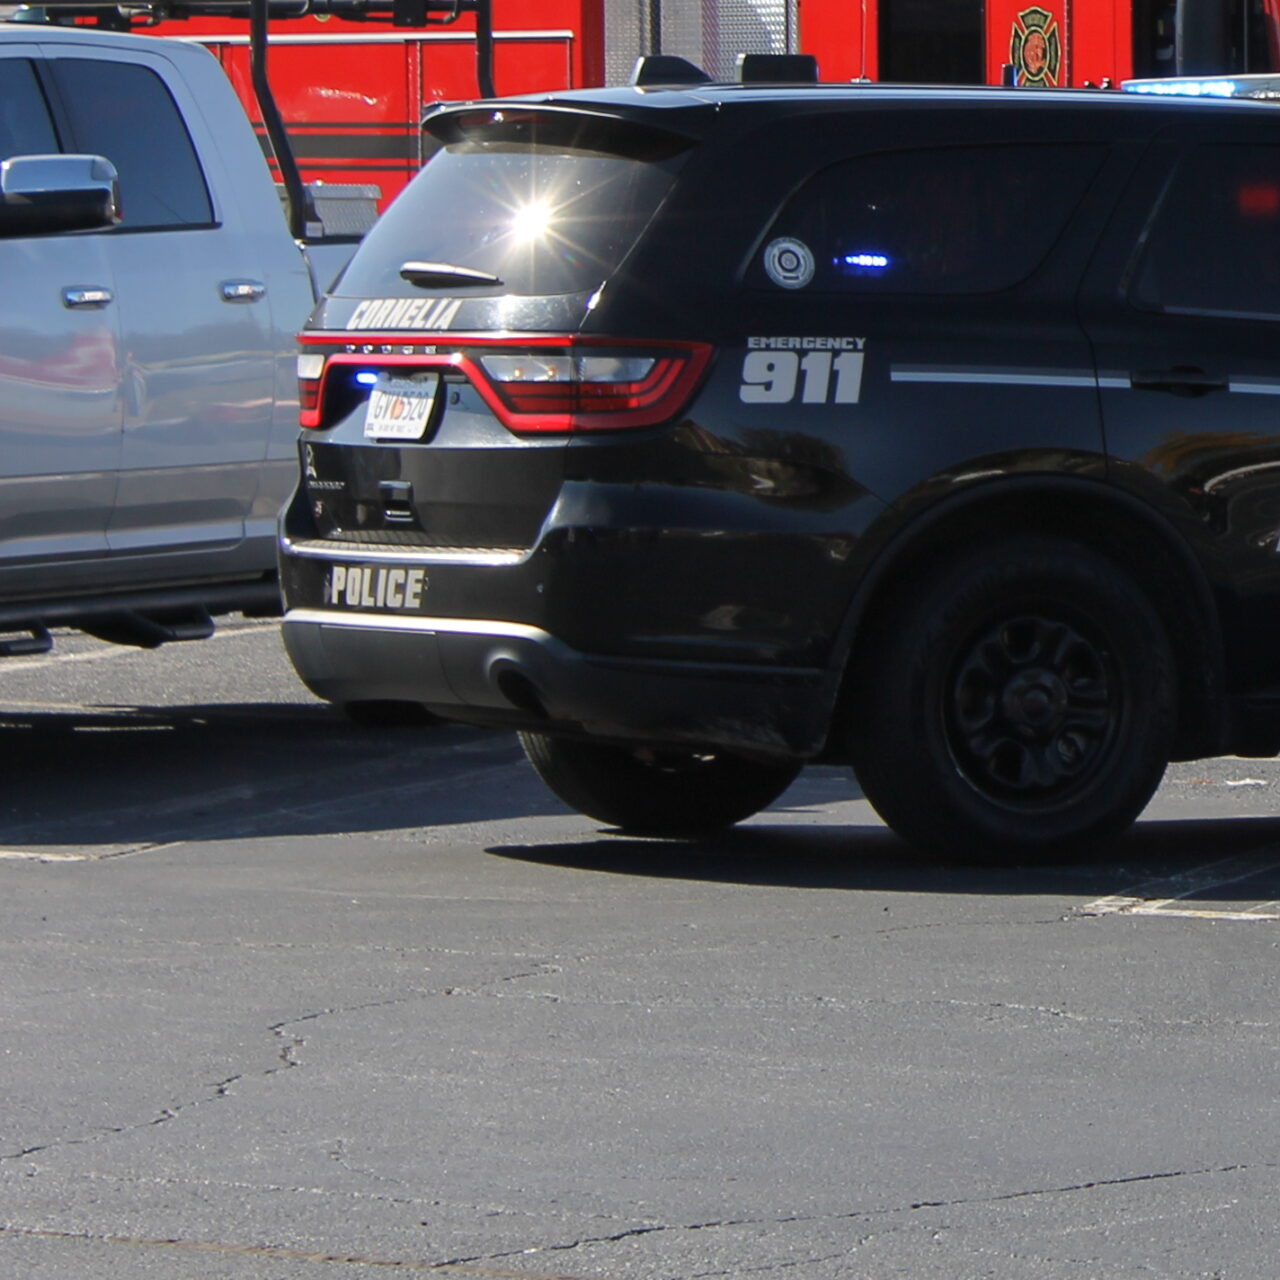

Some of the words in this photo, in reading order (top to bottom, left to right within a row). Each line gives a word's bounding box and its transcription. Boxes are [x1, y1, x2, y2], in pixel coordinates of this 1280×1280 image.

[346, 298, 464, 331] CORNELIA
[747, 336, 866, 349] EMERGENCY
[739, 351, 865, 404] 911
[331, 566, 425, 609] POLICE
